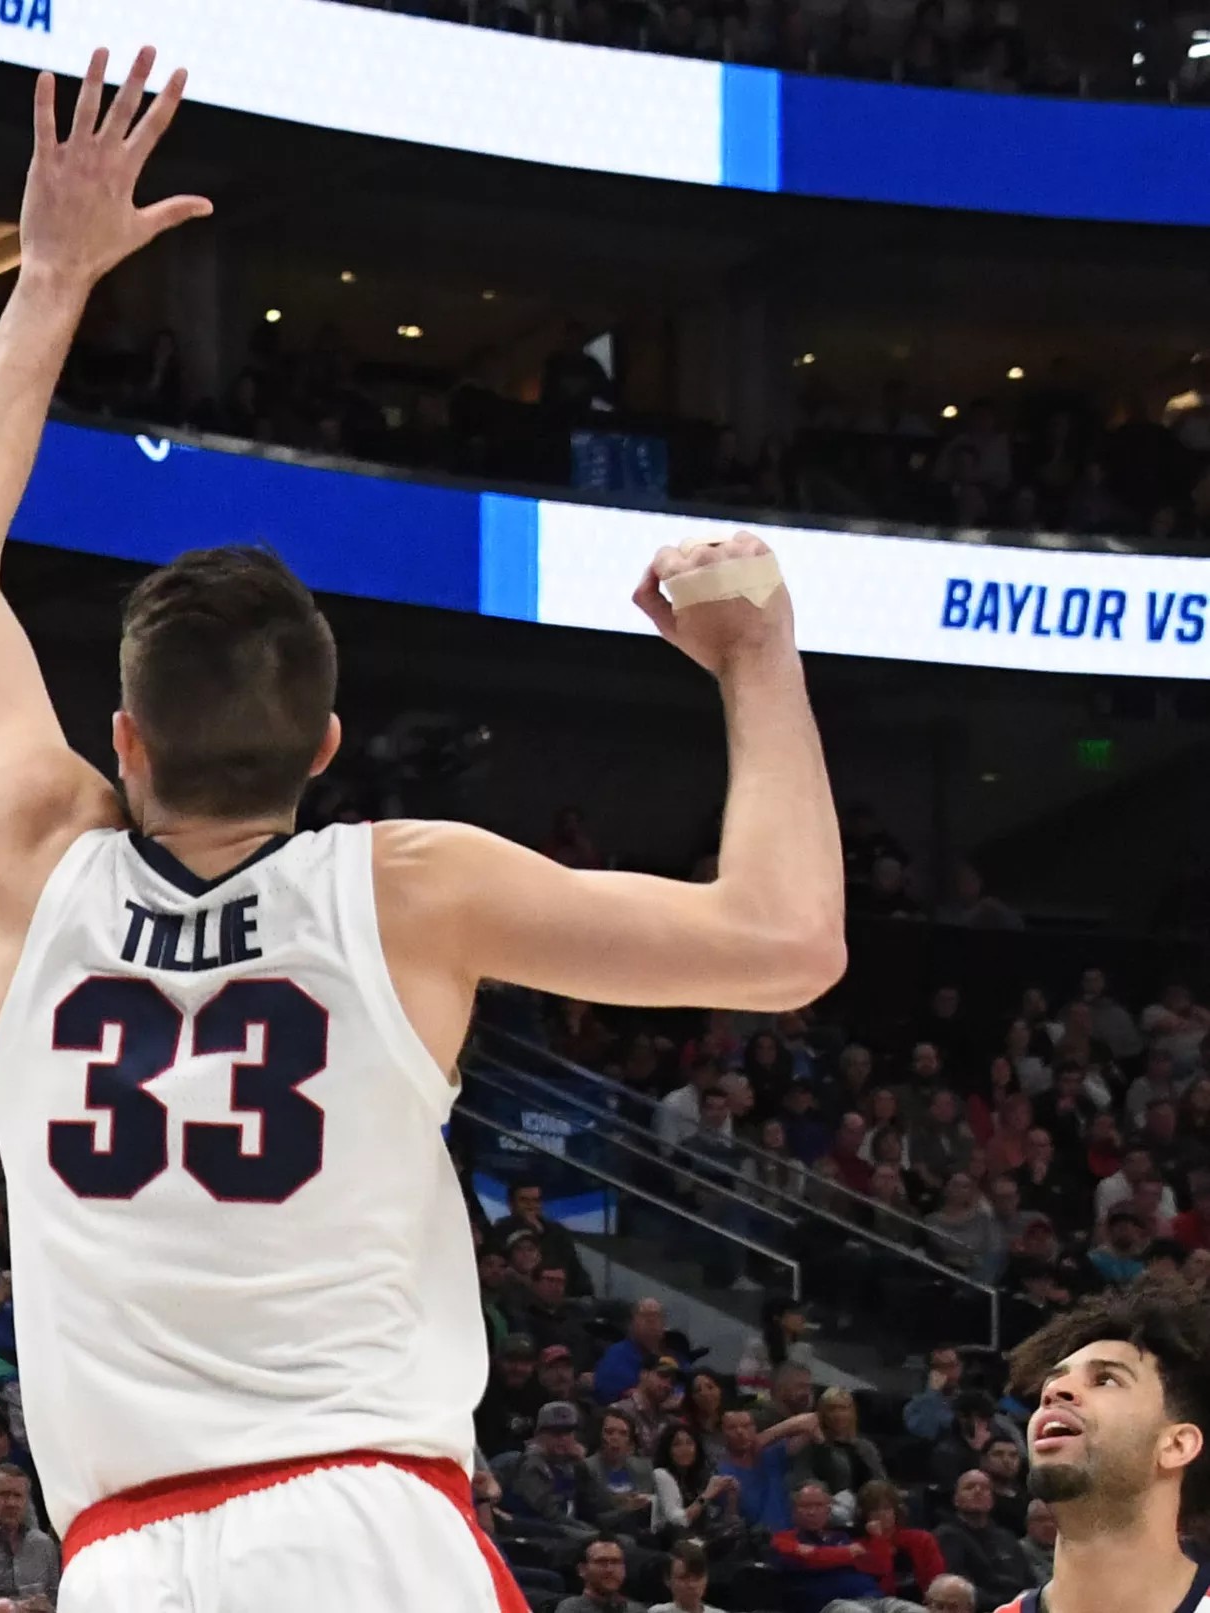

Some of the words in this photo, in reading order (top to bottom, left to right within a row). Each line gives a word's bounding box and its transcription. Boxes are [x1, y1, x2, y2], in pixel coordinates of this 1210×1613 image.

[942, 577, 1127, 640] BAYLOR
[1146, 591, 1208, 643] VS
[120, 894, 263, 972] TILLIE
[47, 975, 329, 1204] 33
